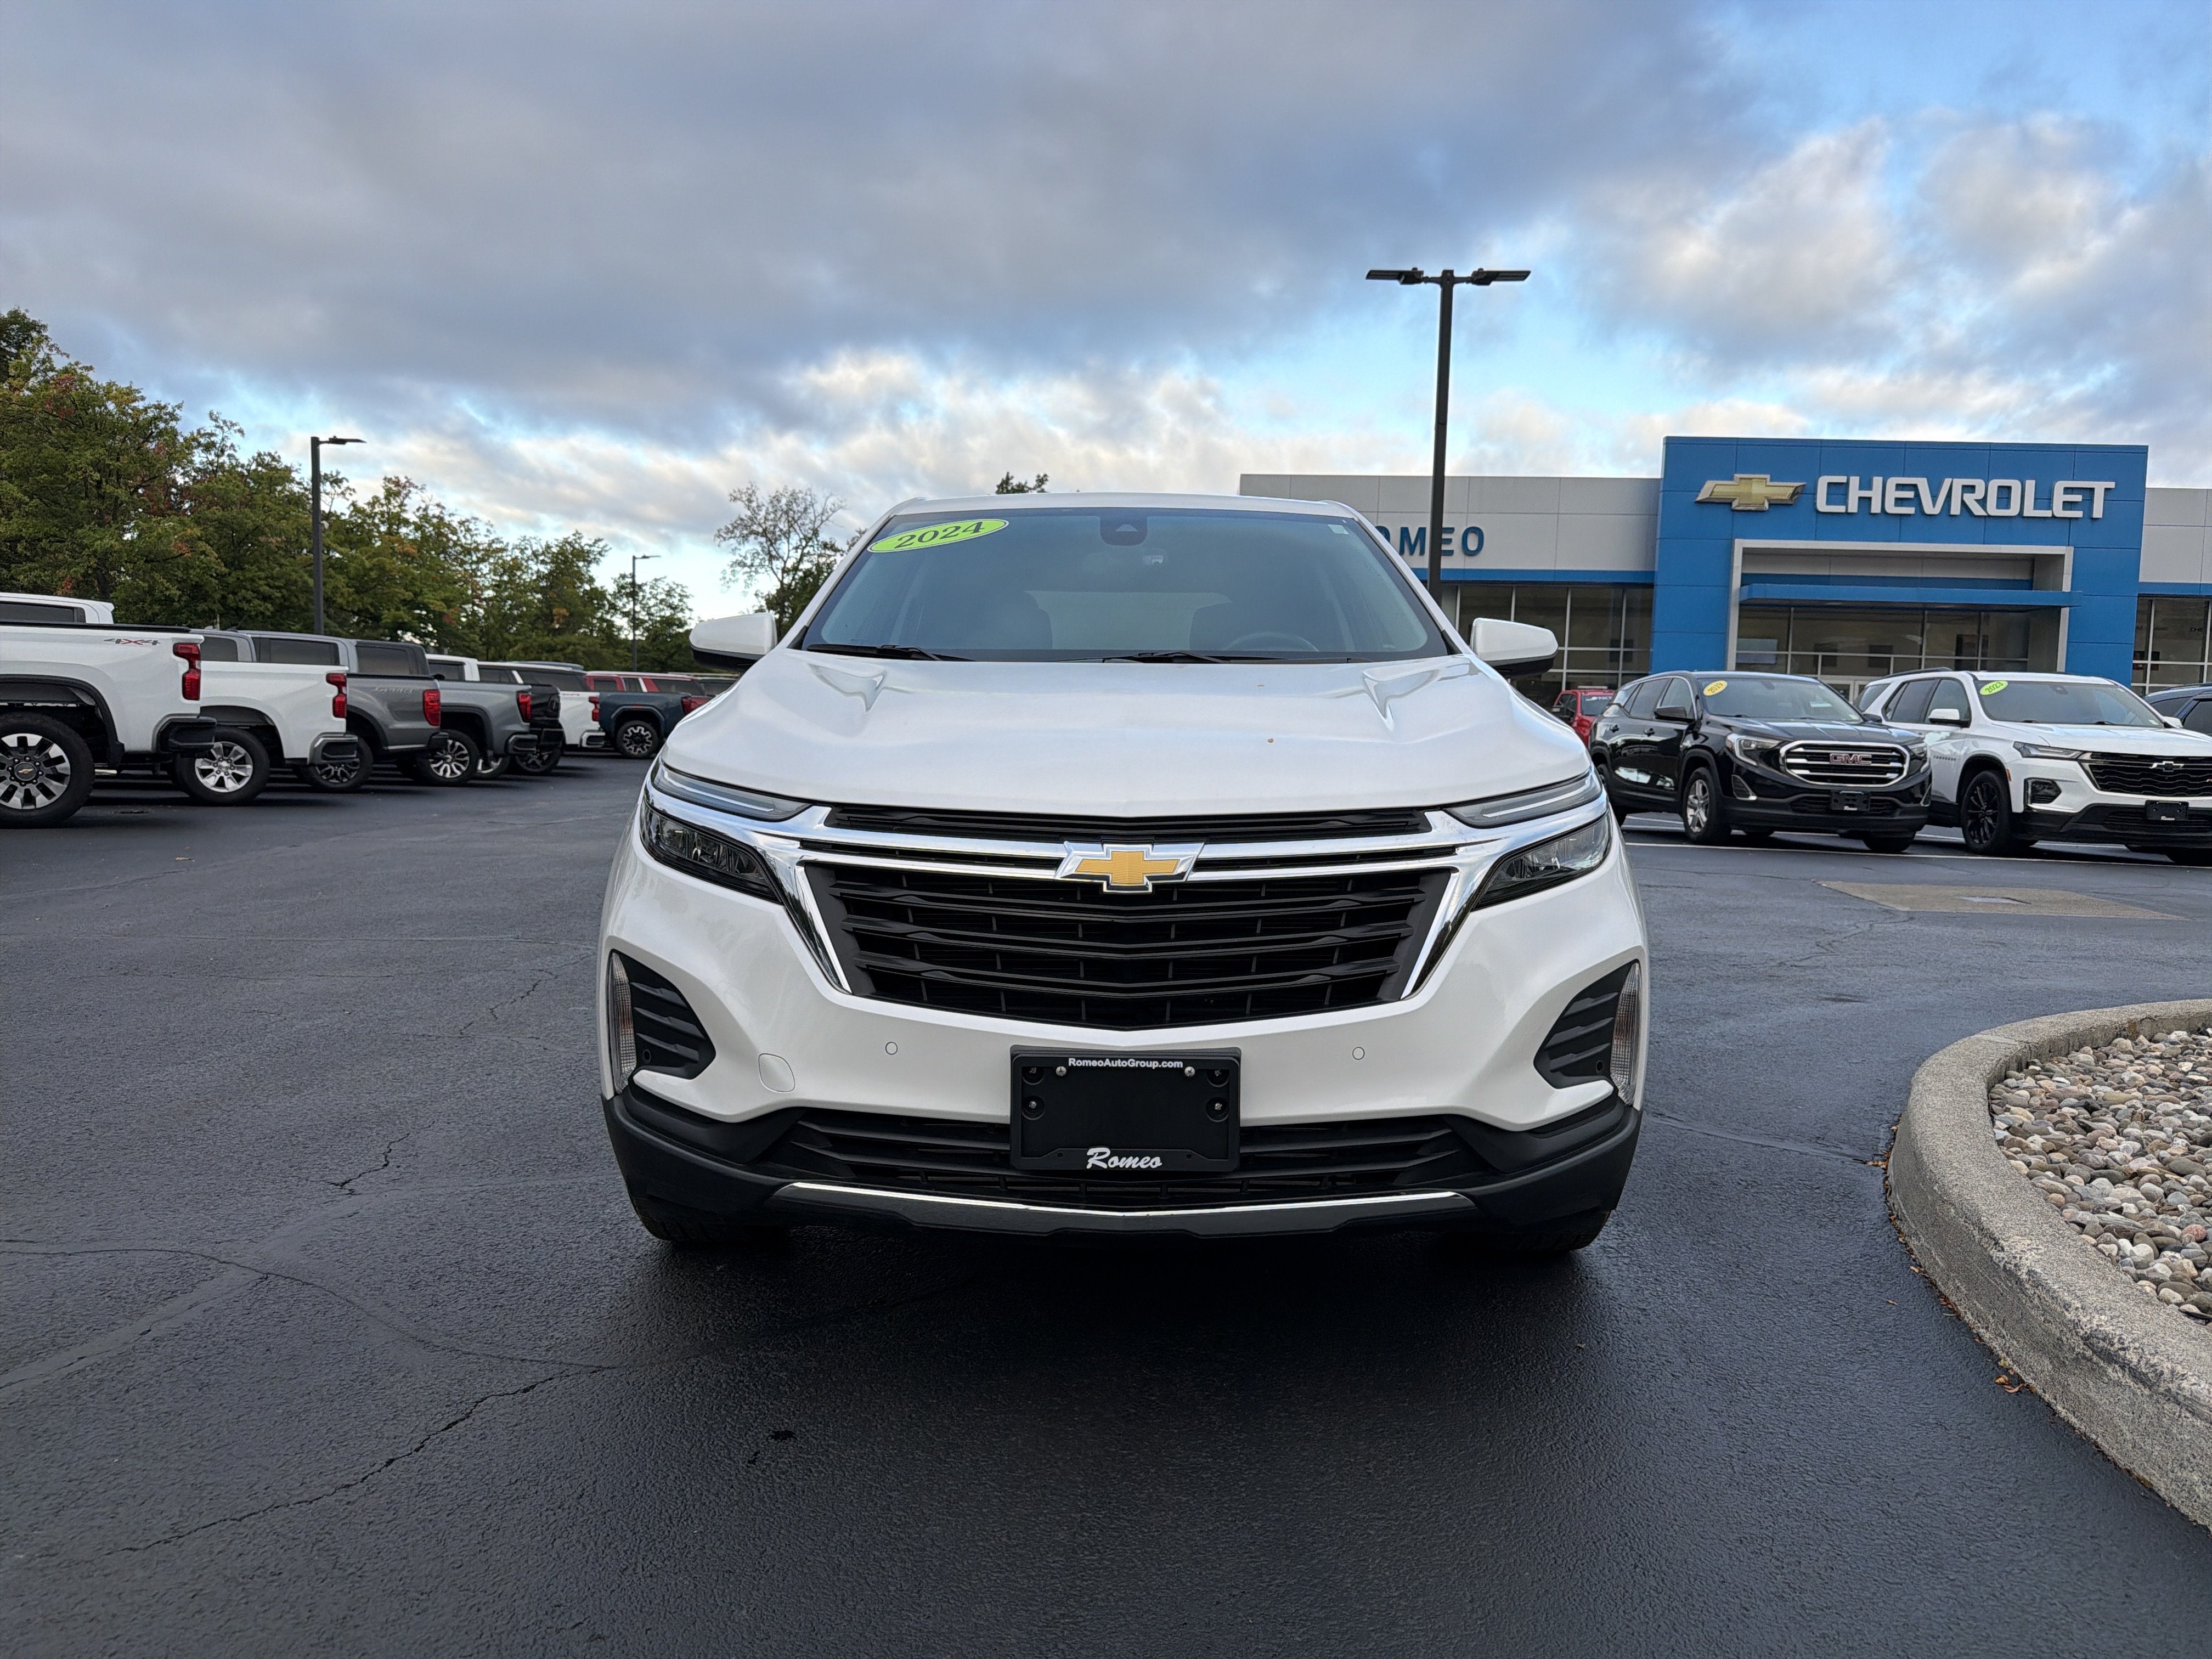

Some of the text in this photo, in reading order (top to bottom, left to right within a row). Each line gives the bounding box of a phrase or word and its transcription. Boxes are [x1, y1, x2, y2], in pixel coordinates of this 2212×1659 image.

[1816, 476, 2116, 518] CHEVROLET
[894, 521, 985, 549] 2024
[1984, 682, 2004, 693] 2023
[1830, 753, 1872, 764] GMC
[1069, 1058, 1183, 1069] RomeoAutoGroup.com
[1086, 1147, 1163, 1169] Romeo
